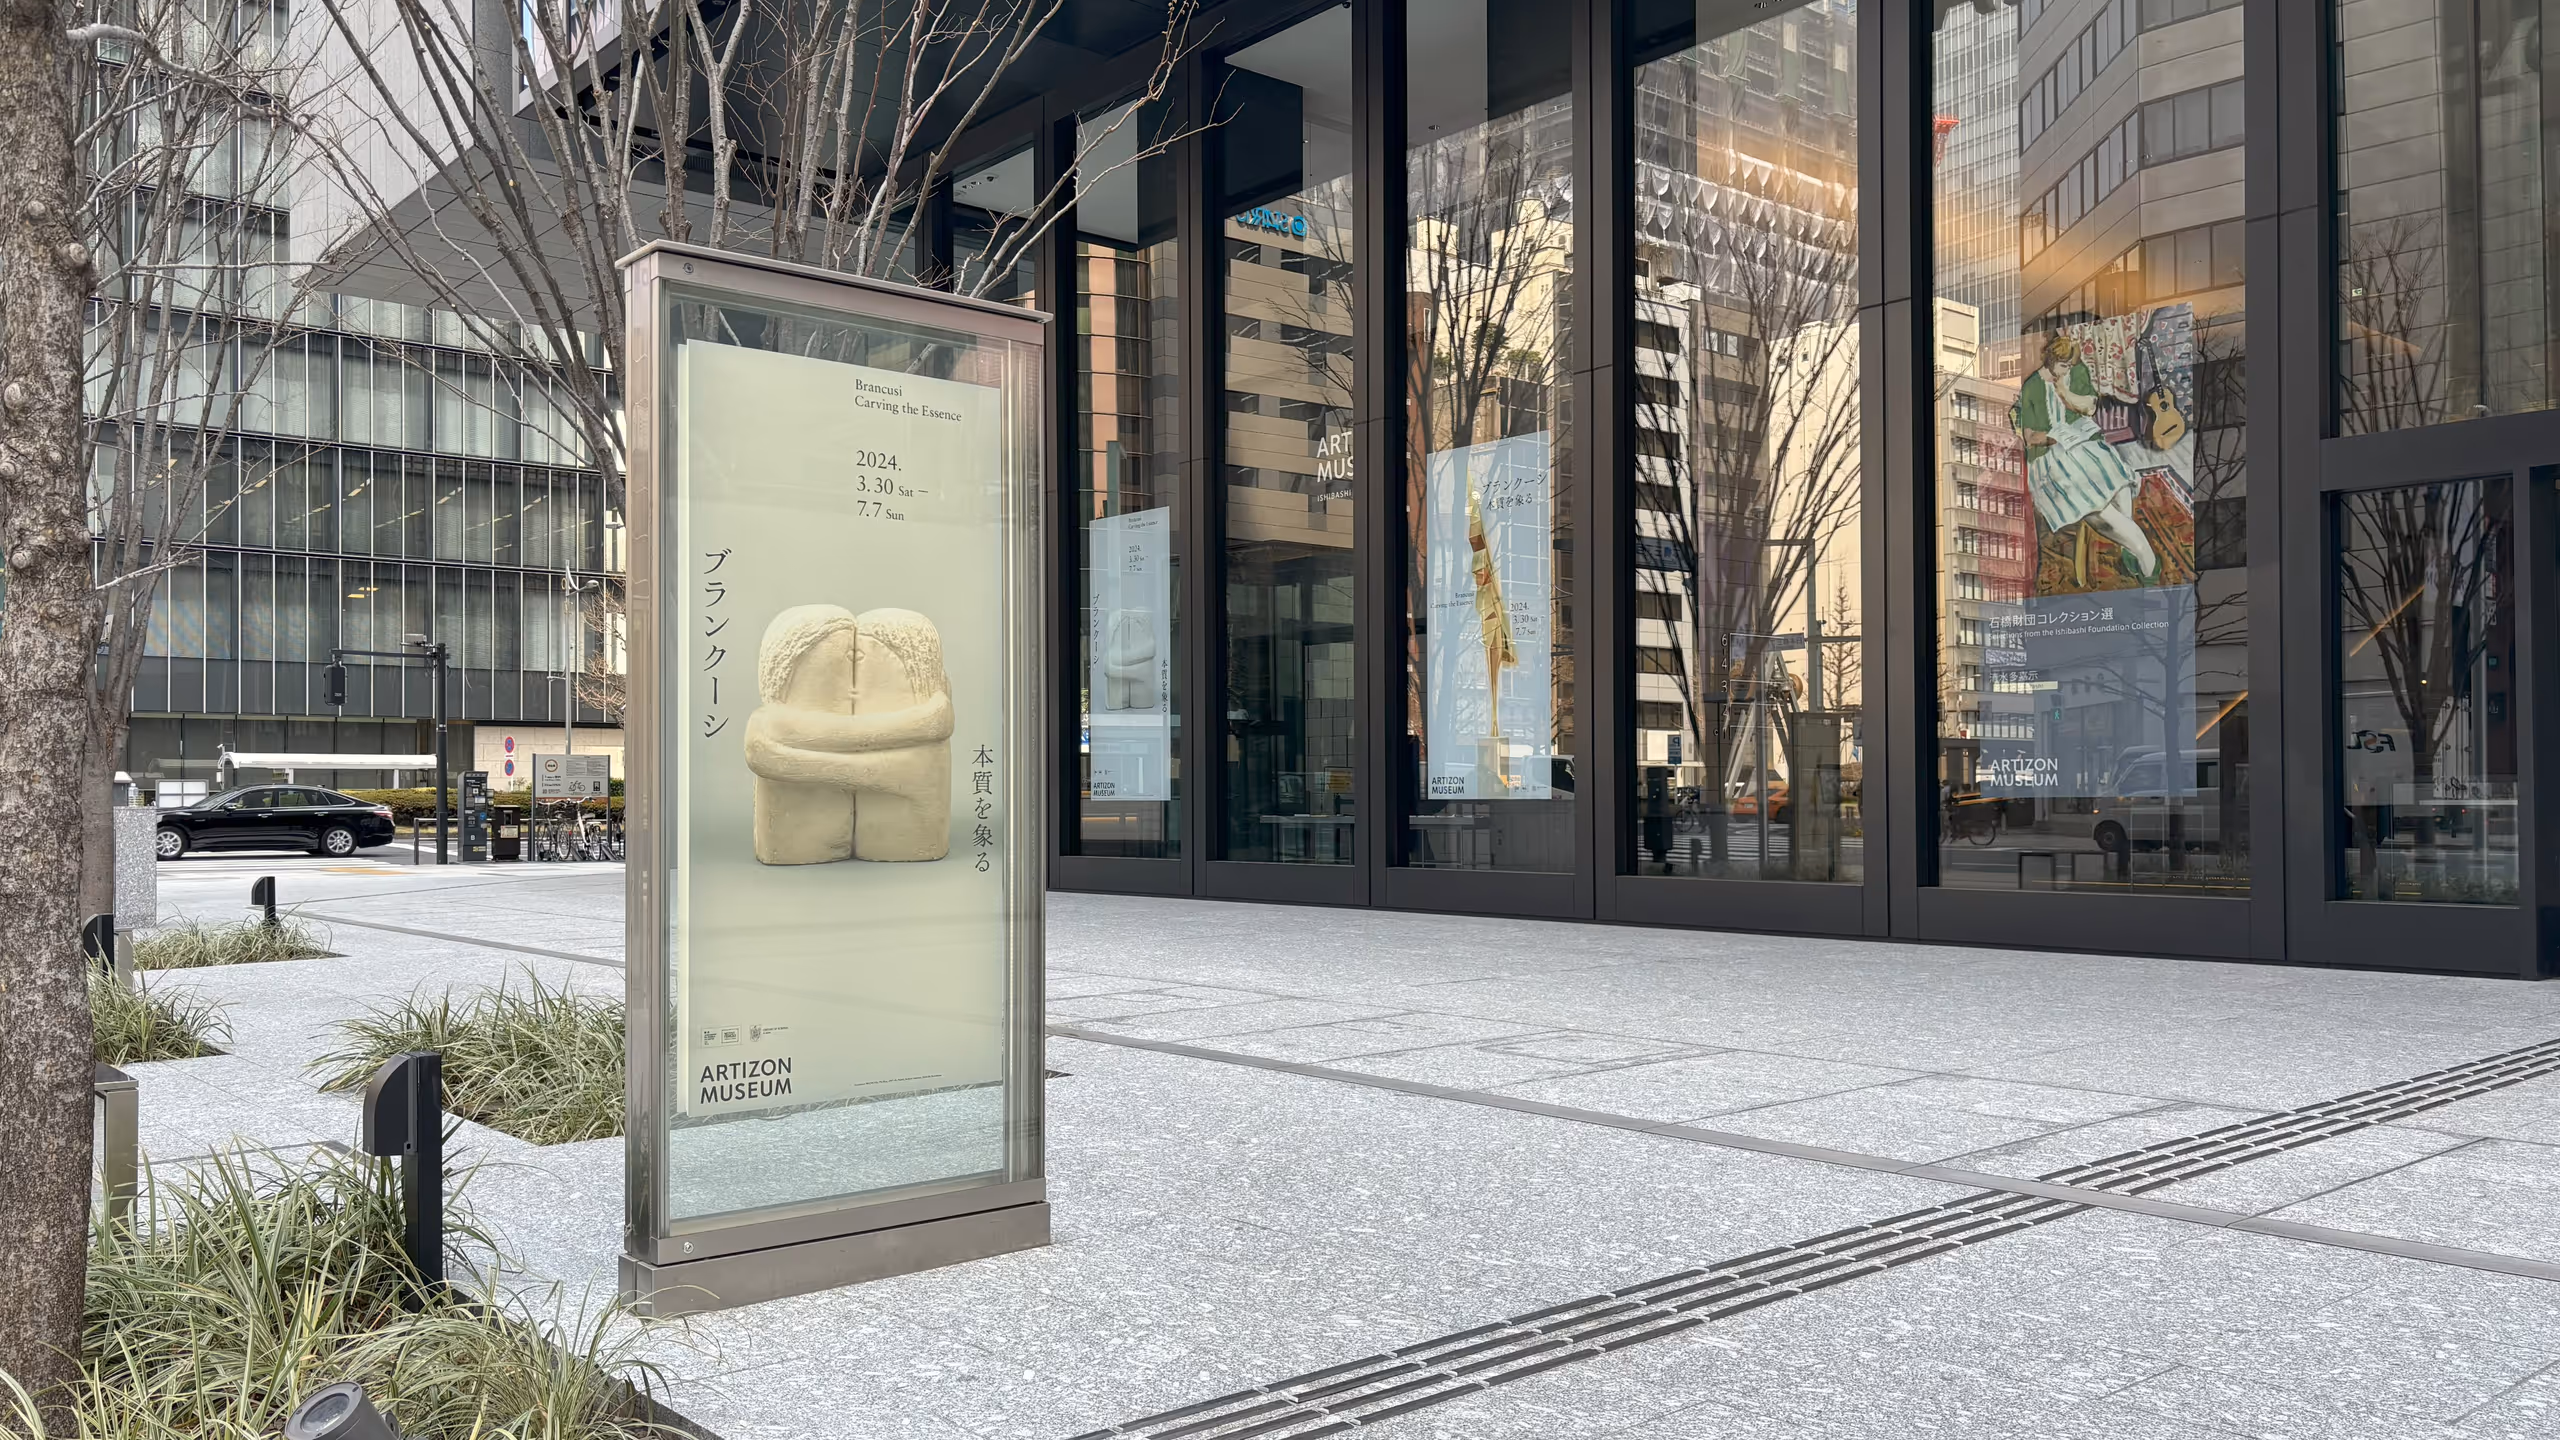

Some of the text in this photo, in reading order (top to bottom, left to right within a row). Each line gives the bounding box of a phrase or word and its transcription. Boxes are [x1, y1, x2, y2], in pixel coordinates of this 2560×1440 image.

[855, 379, 902, 396] Brancusi
[854, 395, 962, 422] Carving the Essence
[856, 450, 902, 471] 2024.
[898, 485, 914, 497] Sat
[1317, 489, 1352, 502] ISHIBASHI
[857, 500, 905, 521] 7.7 Sun
[1988, 607, 2114, 629] 石橋財団コレクション選
[2041, 628, 2054, 636] the
[2055, 626, 2086, 636] Ishibashi
[2087, 623, 2130, 633] Foundation
[2131, 621, 2169, 630] Collection
[704, 548, 732, 738] ブランクーシ
[1990, 758, 2058, 772] ARTIZON
[1431, 776, 1465, 785] ARTIZON
[1990, 773, 2058, 787] MUSEUM
[1431, 786, 1465, 794] MUSEUM
[972, 744, 994, 873] 本質を象る
[700, 1057, 791, 1083] ARTIZON
[700, 1077, 792, 1104] MUSEUM
